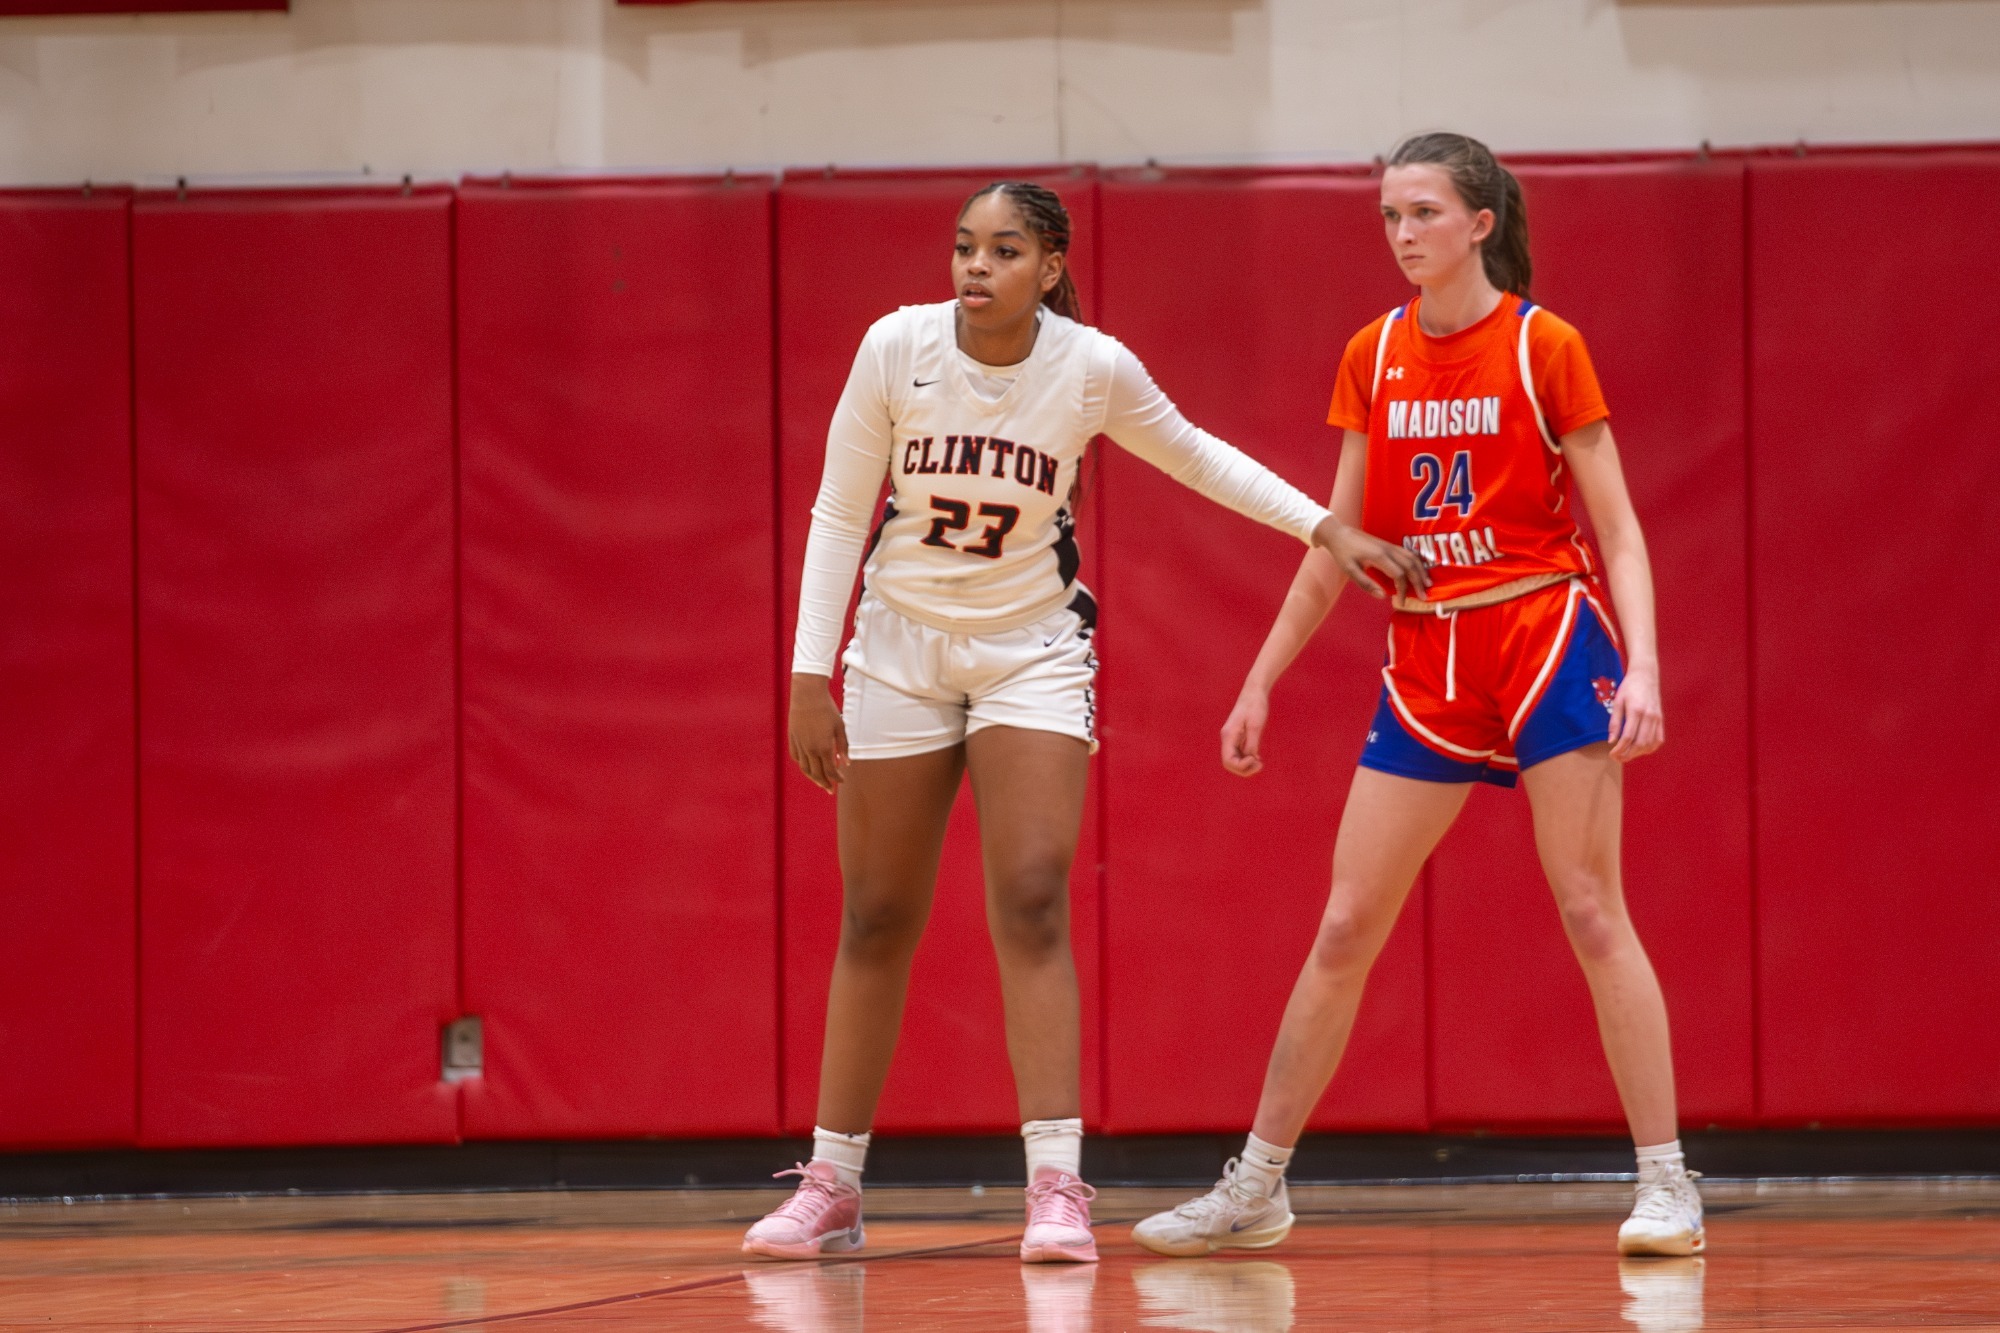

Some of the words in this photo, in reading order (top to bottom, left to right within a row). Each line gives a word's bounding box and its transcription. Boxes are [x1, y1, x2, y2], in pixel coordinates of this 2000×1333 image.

[1387, 396, 1499, 439] MADISON
[903, 435, 1058, 496] CLINTON
[1411, 450, 1474, 521] 24
[920, 494, 1020, 559] 23
